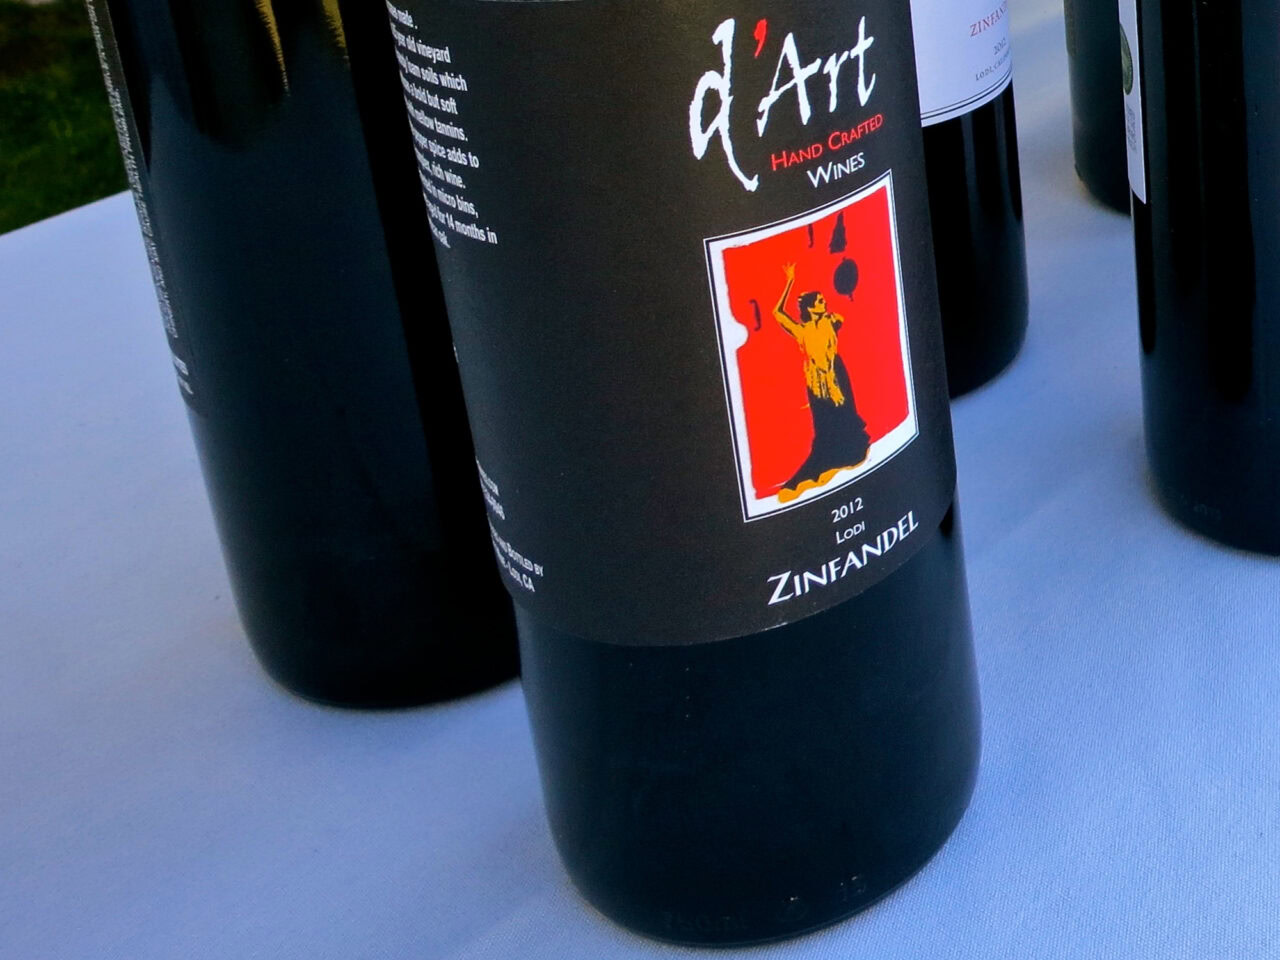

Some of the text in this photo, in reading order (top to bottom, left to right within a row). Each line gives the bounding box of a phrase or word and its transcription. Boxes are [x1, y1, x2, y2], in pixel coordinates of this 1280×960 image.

[415, 39, 451, 64] vineyard
[420, 66, 440, 86] soils
[439, 71, 468, 92] which
[426, 89, 441, 110] but
[440, 96, 459, 115] soft
[689, 15, 877, 193] d'Art
[434, 117, 468, 142] tannins.
[771, 113, 885, 172] HAND CRAFTED
[446, 146, 468, 166] adds
[467, 151, 480, 168] to
[444, 168, 466, 189] wine.
[806, 151, 866, 189] WINES
[455, 194, 479, 219] bins,
[454, 219, 486, 242] months
[486, 226, 498, 244] in
[831, 496, 865, 524] 2012
[835, 520, 867, 545] LODI
[533, 563, 544, 577] BY
[766, 510, 920, 606] ZINFANDEL
[522, 573, 536, 592] CA
